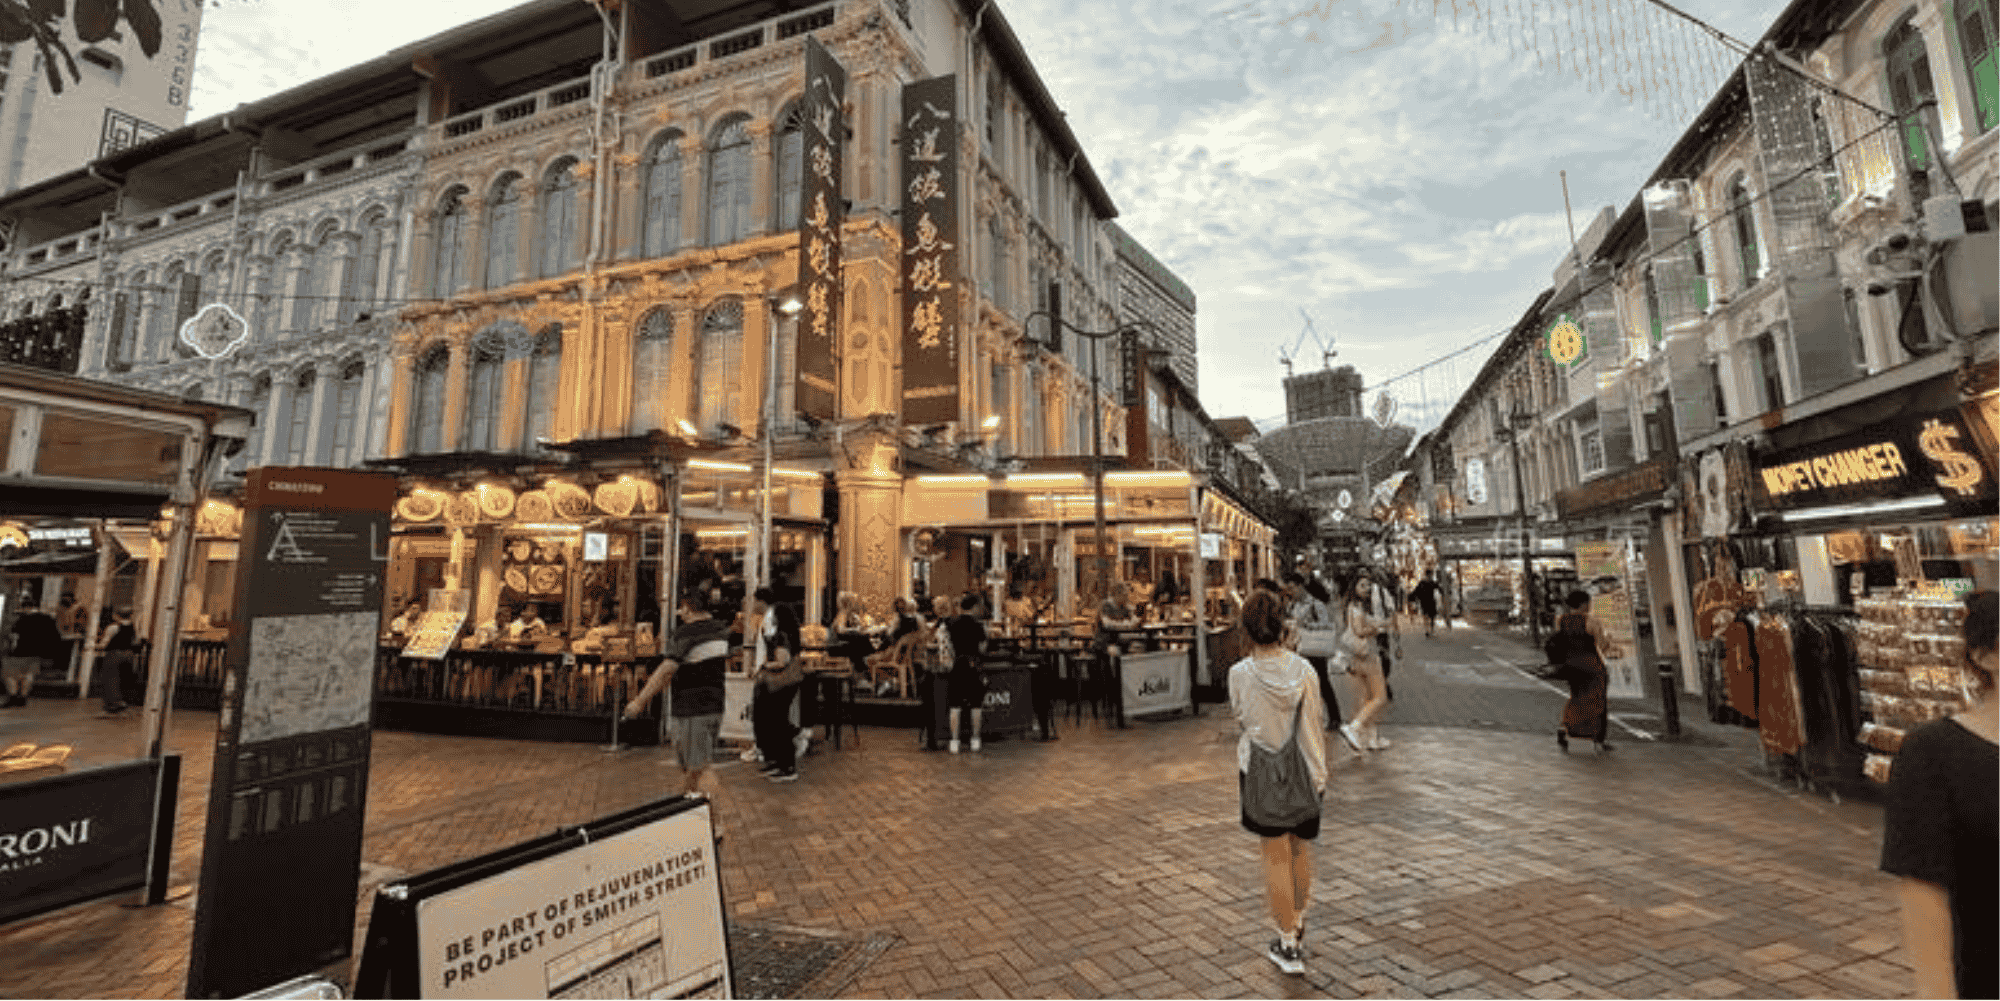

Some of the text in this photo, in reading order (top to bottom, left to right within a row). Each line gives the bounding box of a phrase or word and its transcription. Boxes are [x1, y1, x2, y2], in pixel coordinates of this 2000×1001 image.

[1812, 442, 1908, 488] CHANGER
[1918, 418, 1983, 496] $
[442, 863, 706, 989] PROJECT OF SMITH STREET!
[444, 847, 704, 962] BE PART OF REJUVENATION
